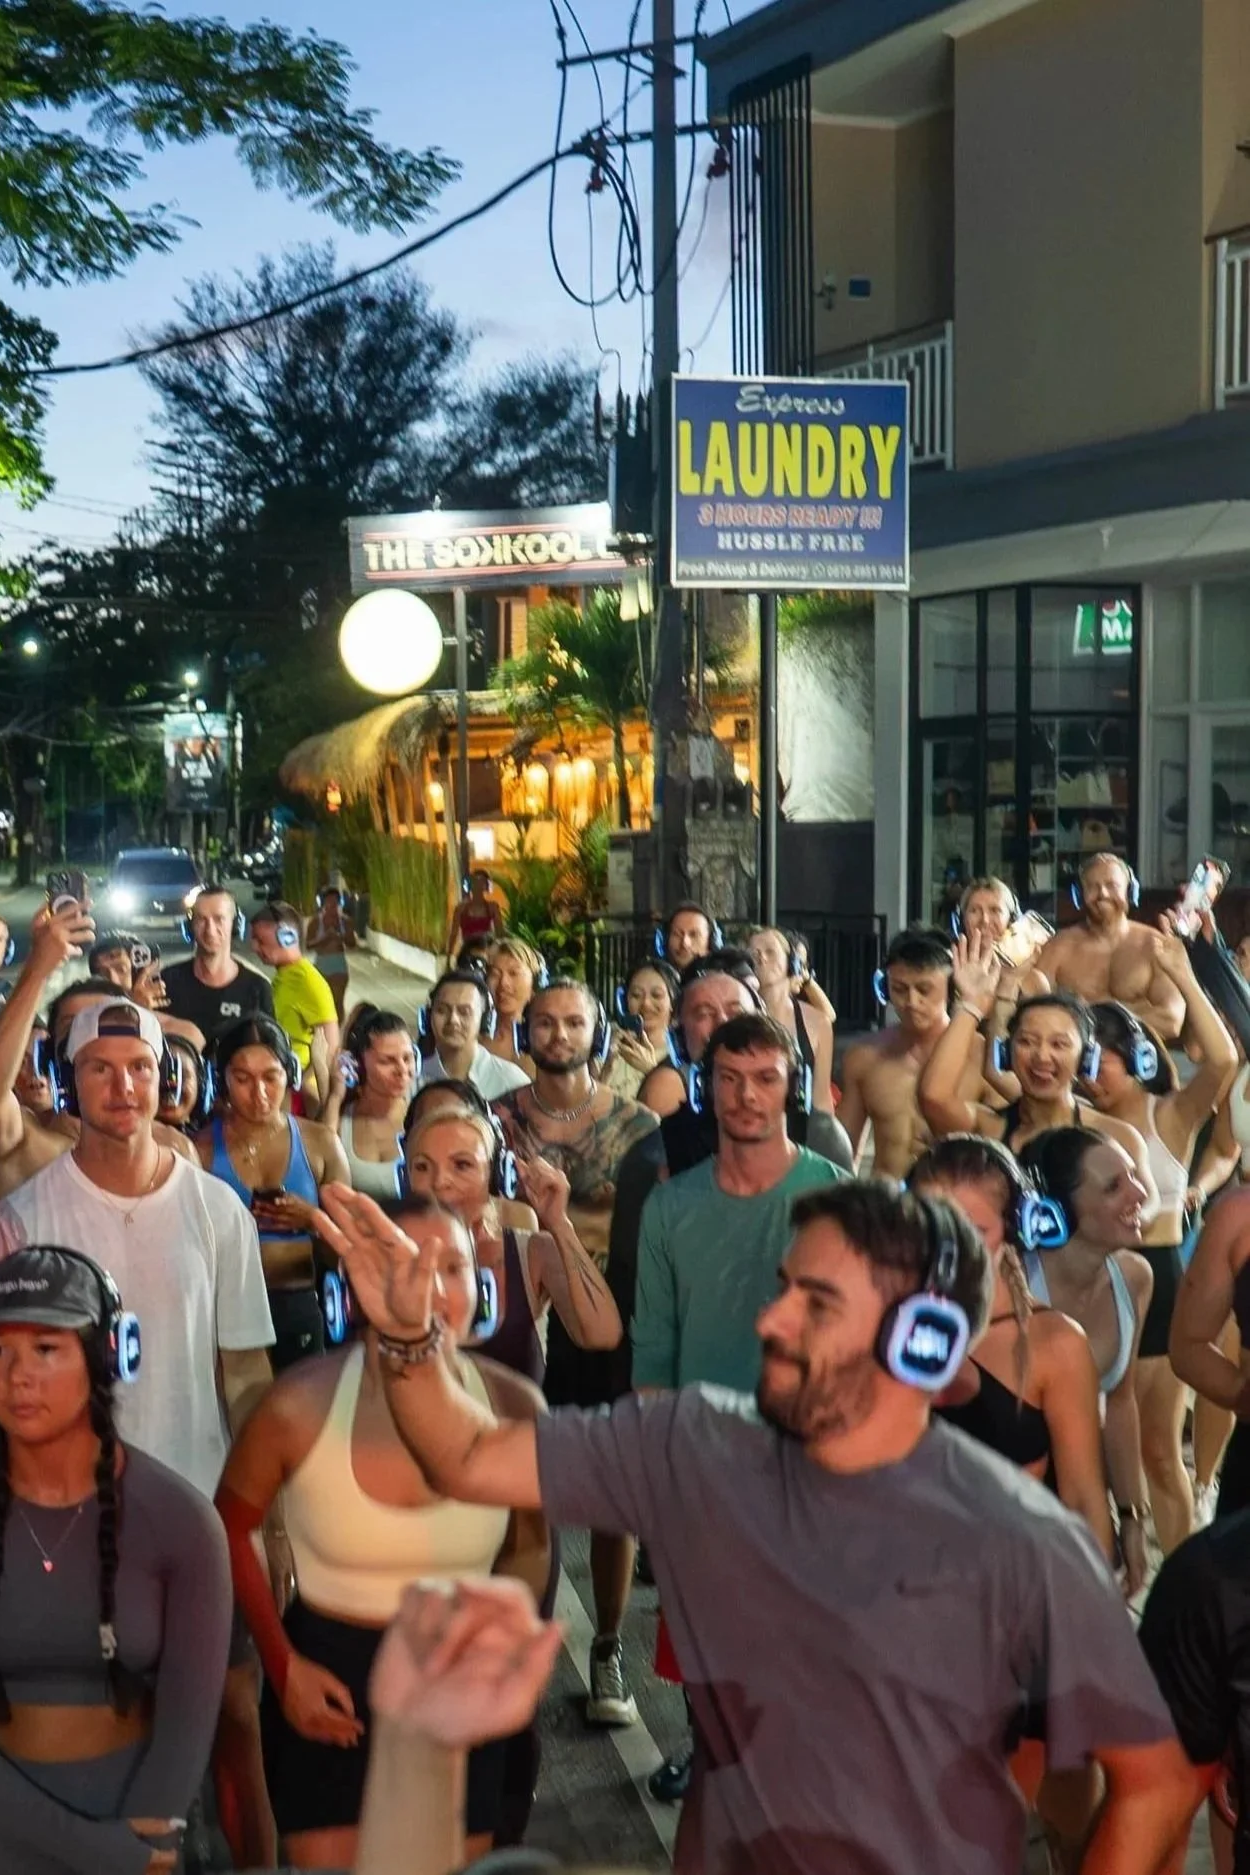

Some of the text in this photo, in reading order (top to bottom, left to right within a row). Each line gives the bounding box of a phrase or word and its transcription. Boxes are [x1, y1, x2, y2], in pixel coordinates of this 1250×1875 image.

[735, 384, 845, 418] Express
[677, 420, 901, 499] LAUNDRY
[715, 502, 787, 528] HOURS
[788, 504, 858, 529] READY
[362, 540, 426, 571] THE
[717, 532, 865, 552] HUSSLE FREE
